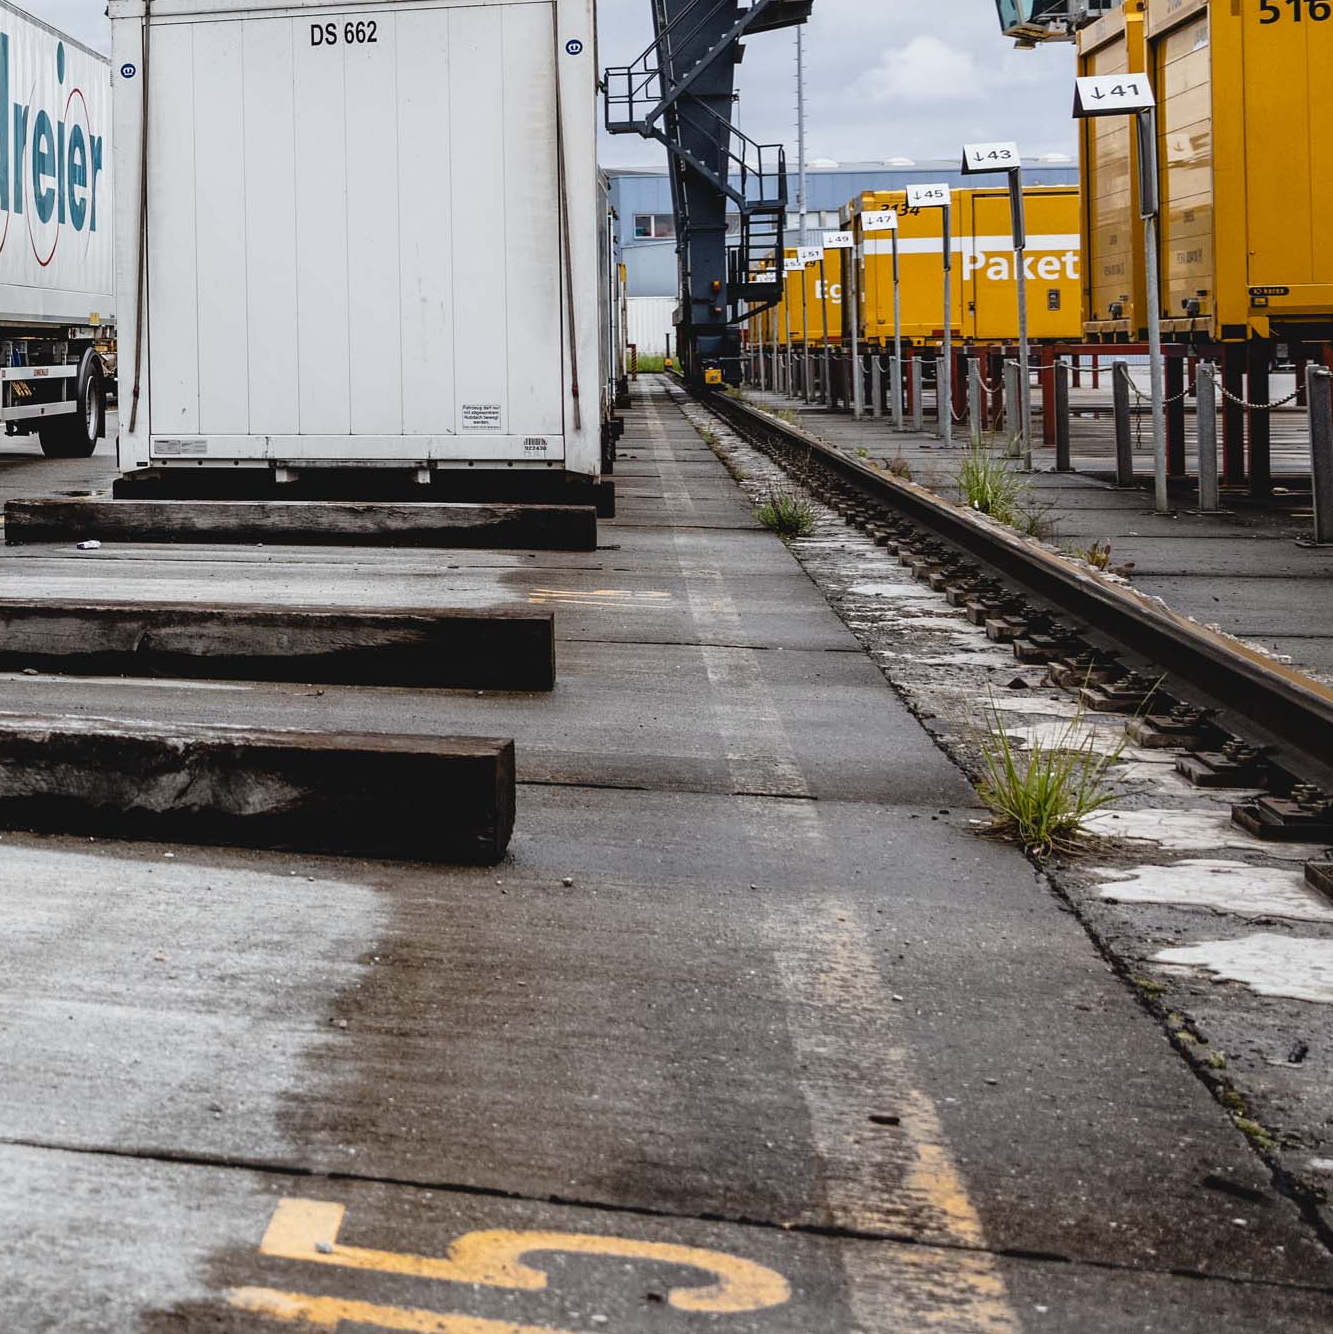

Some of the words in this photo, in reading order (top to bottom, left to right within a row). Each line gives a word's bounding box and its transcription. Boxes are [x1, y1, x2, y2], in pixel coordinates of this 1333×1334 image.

[310, 22, 338, 46] DS
[344, 20, 377, 44] 662
[1110, 83, 1139, 97] 41
[987, 149, 1012, 160] 43
[924, 188, 944, 199] 45
[874, 214, 892, 225] 47
[963, 250, 1080, 281] Paket
